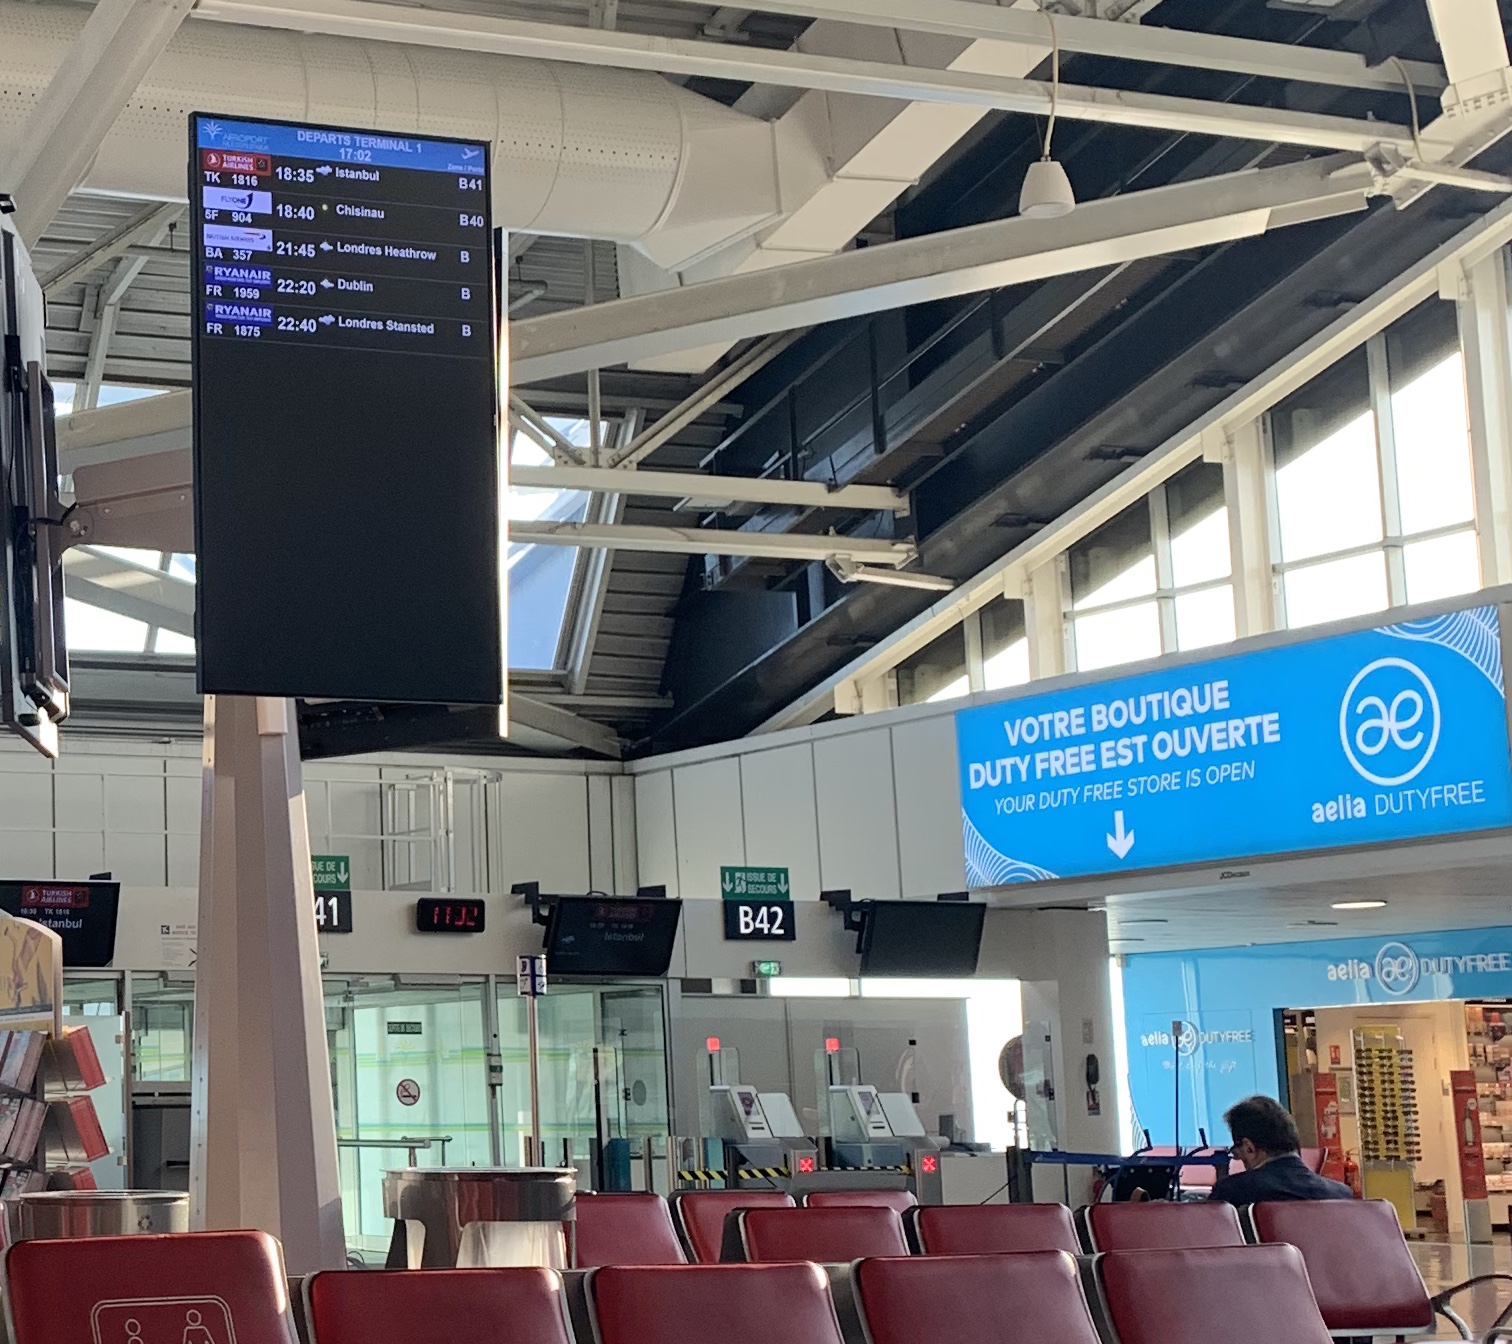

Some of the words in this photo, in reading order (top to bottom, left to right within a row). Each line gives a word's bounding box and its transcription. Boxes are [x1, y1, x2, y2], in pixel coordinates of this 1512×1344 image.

[297, 130, 351, 146] DEPARTS
[354, 136, 413, 153] TERMINAL
[416, 143, 422, 154] 1
[222, 154, 254, 164] TURKISH
[339, 147, 372, 162] 17:02
[204, 171, 221, 184] TK
[231, 174, 258, 187] 1816
[276, 166, 315, 183] 18:35
[335, 167, 380, 181] Istanbul
[458, 177, 483, 191] B41
[204, 209, 219, 220] 5F
[231, 211, 253, 223] 904
[276, 203, 315, 220] 18:40
[336, 204, 385, 219] Chisinau
[459, 214, 484, 227] B40
[205, 246, 223, 259] BA
[232, 249, 253, 261] 357
[276, 241, 316, 257] 21:45
[337, 242, 382, 256] Londres
[385, 246, 437, 260] Heathrow
[460, 250, 470, 263] B
[214, 266, 271, 280] RYANAIR
[206, 284, 222, 296] FR
[233, 287, 260, 299] 1959
[277, 278, 316, 295] 22:20
[337, 279, 374, 292] Dublin
[461, 287, 471, 300] B
[215, 304, 272, 318] RYANAIR
[206, 322, 223, 334] FR
[234, 324, 261, 337] 1875
[277, 316, 317, 333] 22:40
[338, 316, 384, 330] Londres
[386, 320, 435, 334] Stansted
[462, 325, 471, 337] B
[1004, 706, 1087, 747] VOTRE
[1092, 679, 1231, 733] BOUTIQUE
[969, 753, 1030, 790] DUTY
[1035, 744, 1097, 780] FREE
[1102, 735, 1149, 770] EST
[1151, 712, 1281, 761] OUVERTE
[995, 794, 1036, 816] YOUR
[1039, 787, 1081, 811] DUTY
[1083, 781, 1123, 804] FREE
[1127, 772, 1182, 798] STORE
[1185, 768, 1202, 789] IS
[1206, 760, 1256, 785] OPEN
[1311, 795, 1367, 824] aelia
[1375, 779, 1486, 817] DUTYFREE
[312, 861, 324, 871] SUE
[326, 861, 336, 871] DE
[313, 873, 337, 884] COURS
[746, 872, 766, 883] ISSUE
[768, 873, 777, 883] DE
[42, 889, 72, 897] TURKISH
[747, 884, 778, 895] SECOURS
[315, 896, 339, 926] 41
[738, 905, 785, 935] B42
[1326, 959, 1371, 981] aelia
[1420, 952, 1512, 976] DUTYFREE
[1140, 1030, 1169, 1047] aelia
[1199, 1030, 1252, 1044] DUTYFREE
